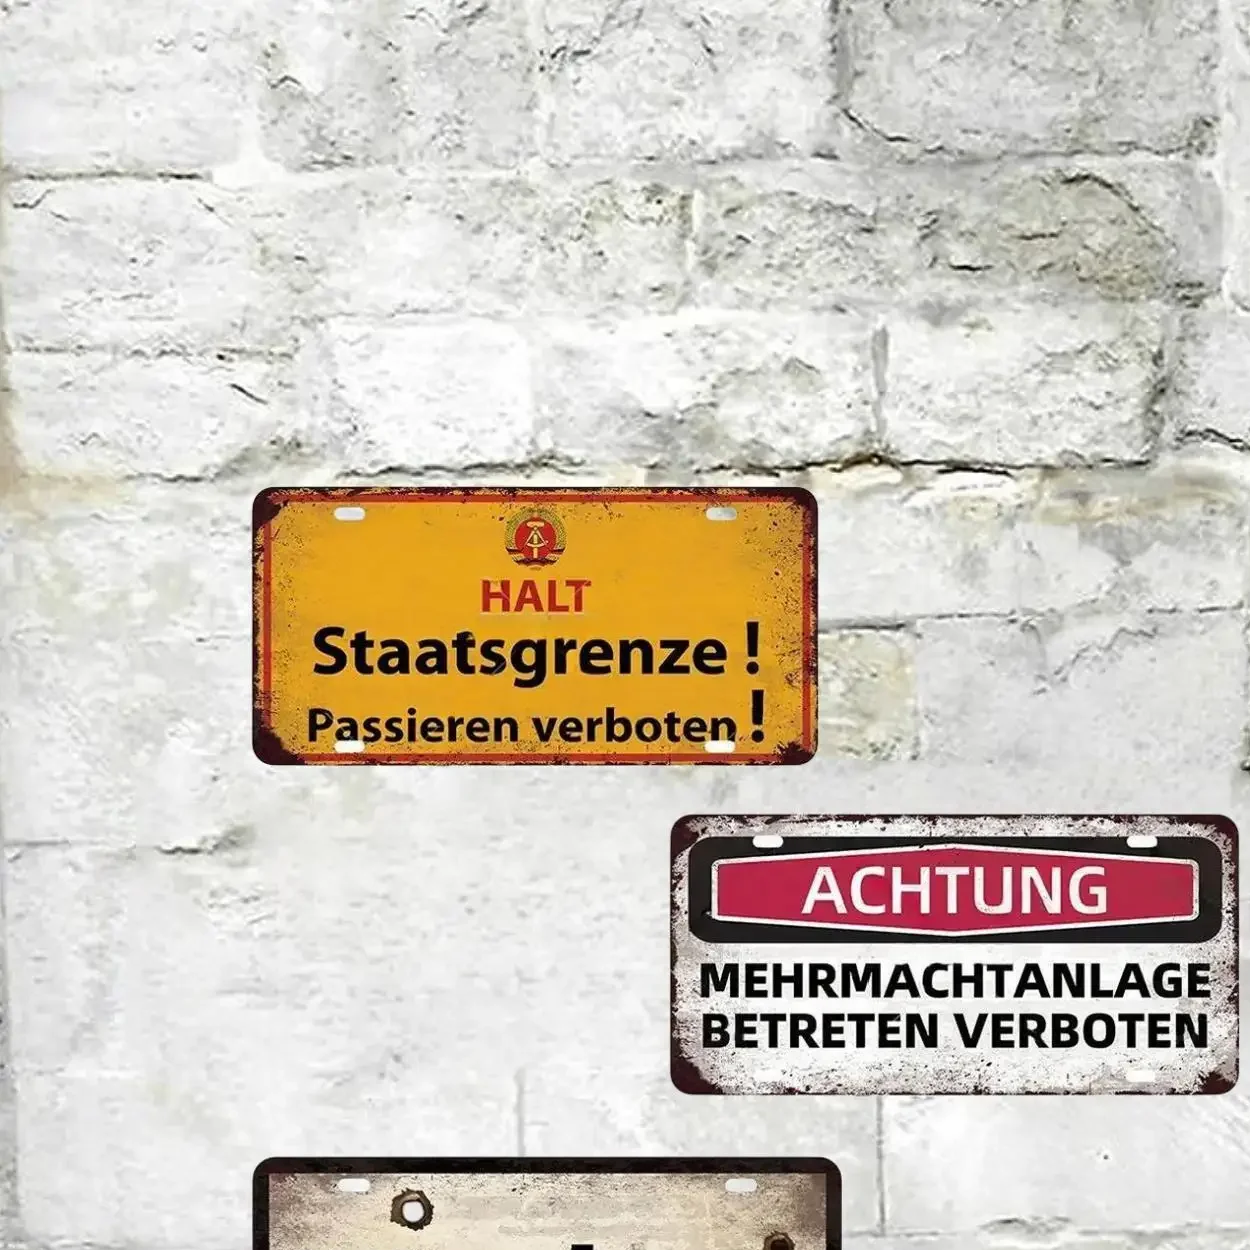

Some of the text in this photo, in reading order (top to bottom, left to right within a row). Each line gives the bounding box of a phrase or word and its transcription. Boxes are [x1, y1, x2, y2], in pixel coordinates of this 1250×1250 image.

[481, 579, 591, 613] HALT
[308, 707, 519, 743] Passieren
[801, 866, 1108, 915] ACHTUNG
[700, 962, 1212, 999] MEHRMACHTANLAGE
[702, 1012, 1208, 1049] BETRETEN VERBOTEN
